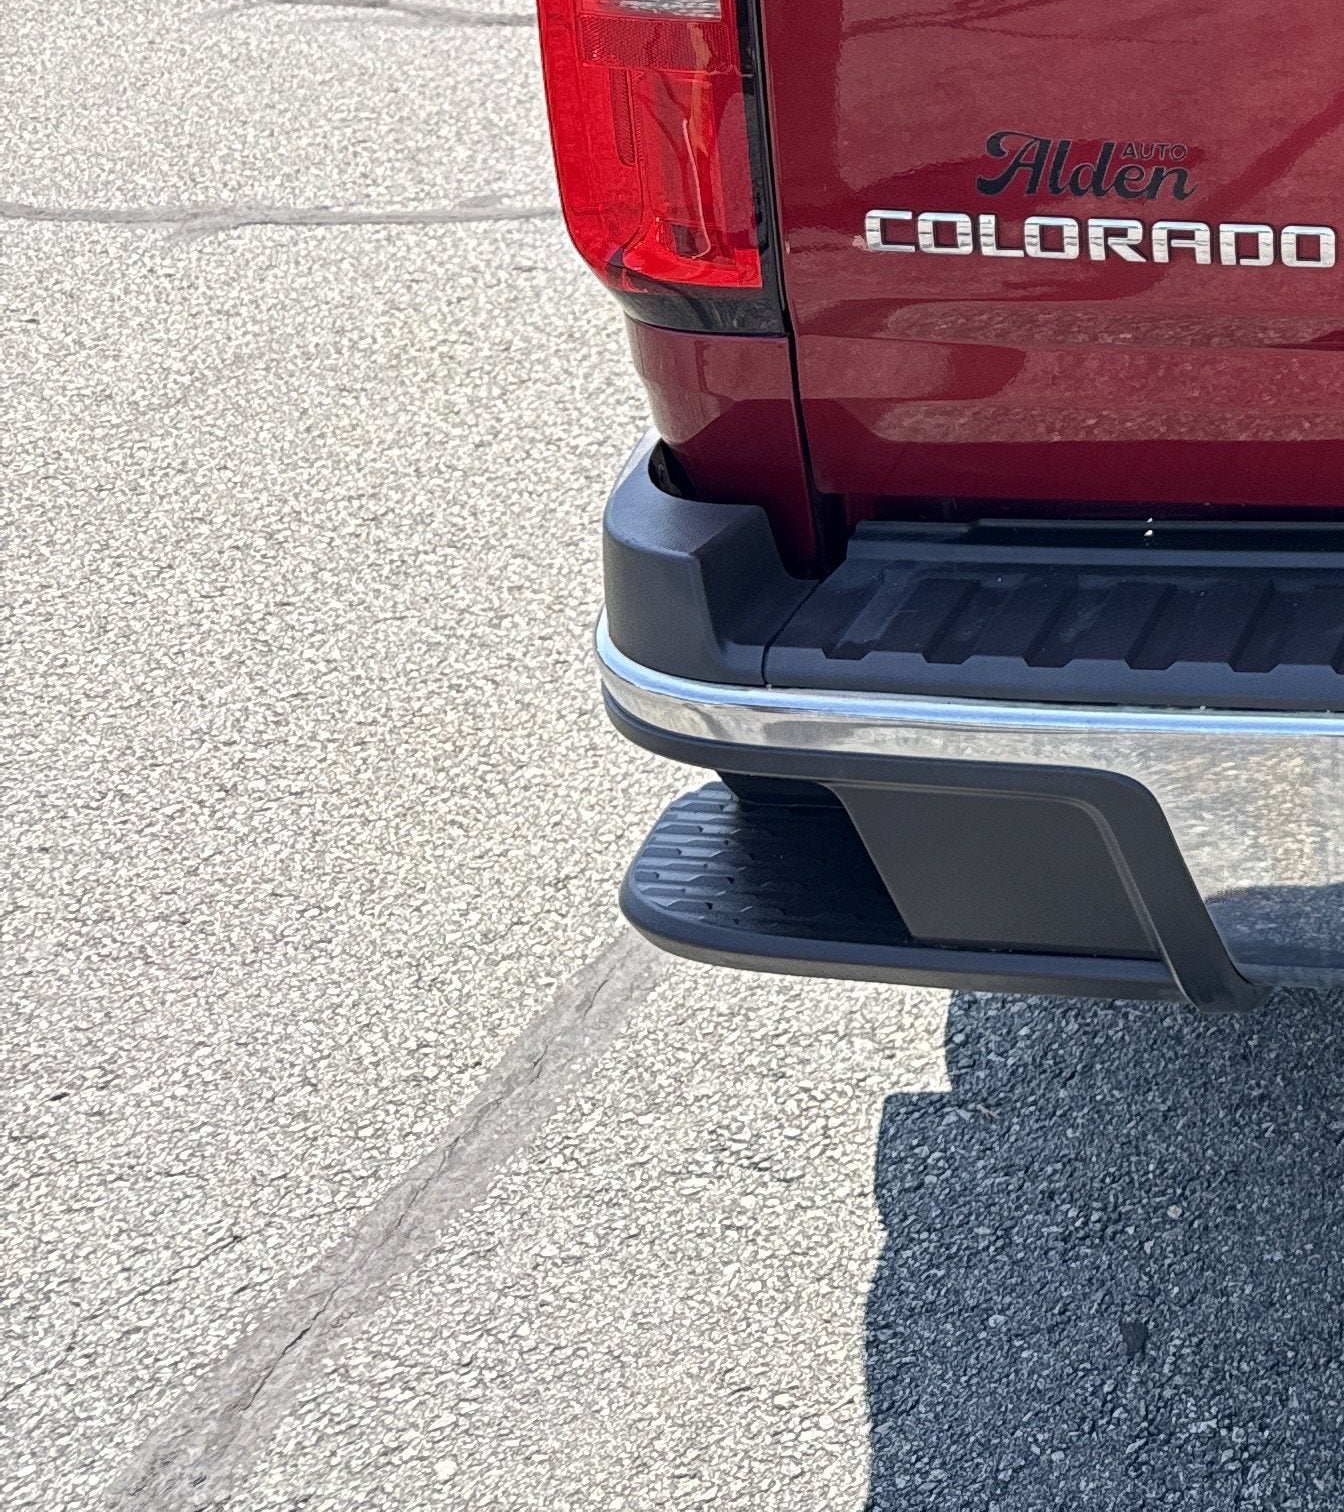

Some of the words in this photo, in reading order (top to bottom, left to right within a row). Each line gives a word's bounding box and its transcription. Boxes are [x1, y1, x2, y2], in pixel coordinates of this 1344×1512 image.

[975, 128, 1198, 202] Alden
[1121, 142, 1188, 161] AUTO
[864, 208, 1337, 270] COLORADO
